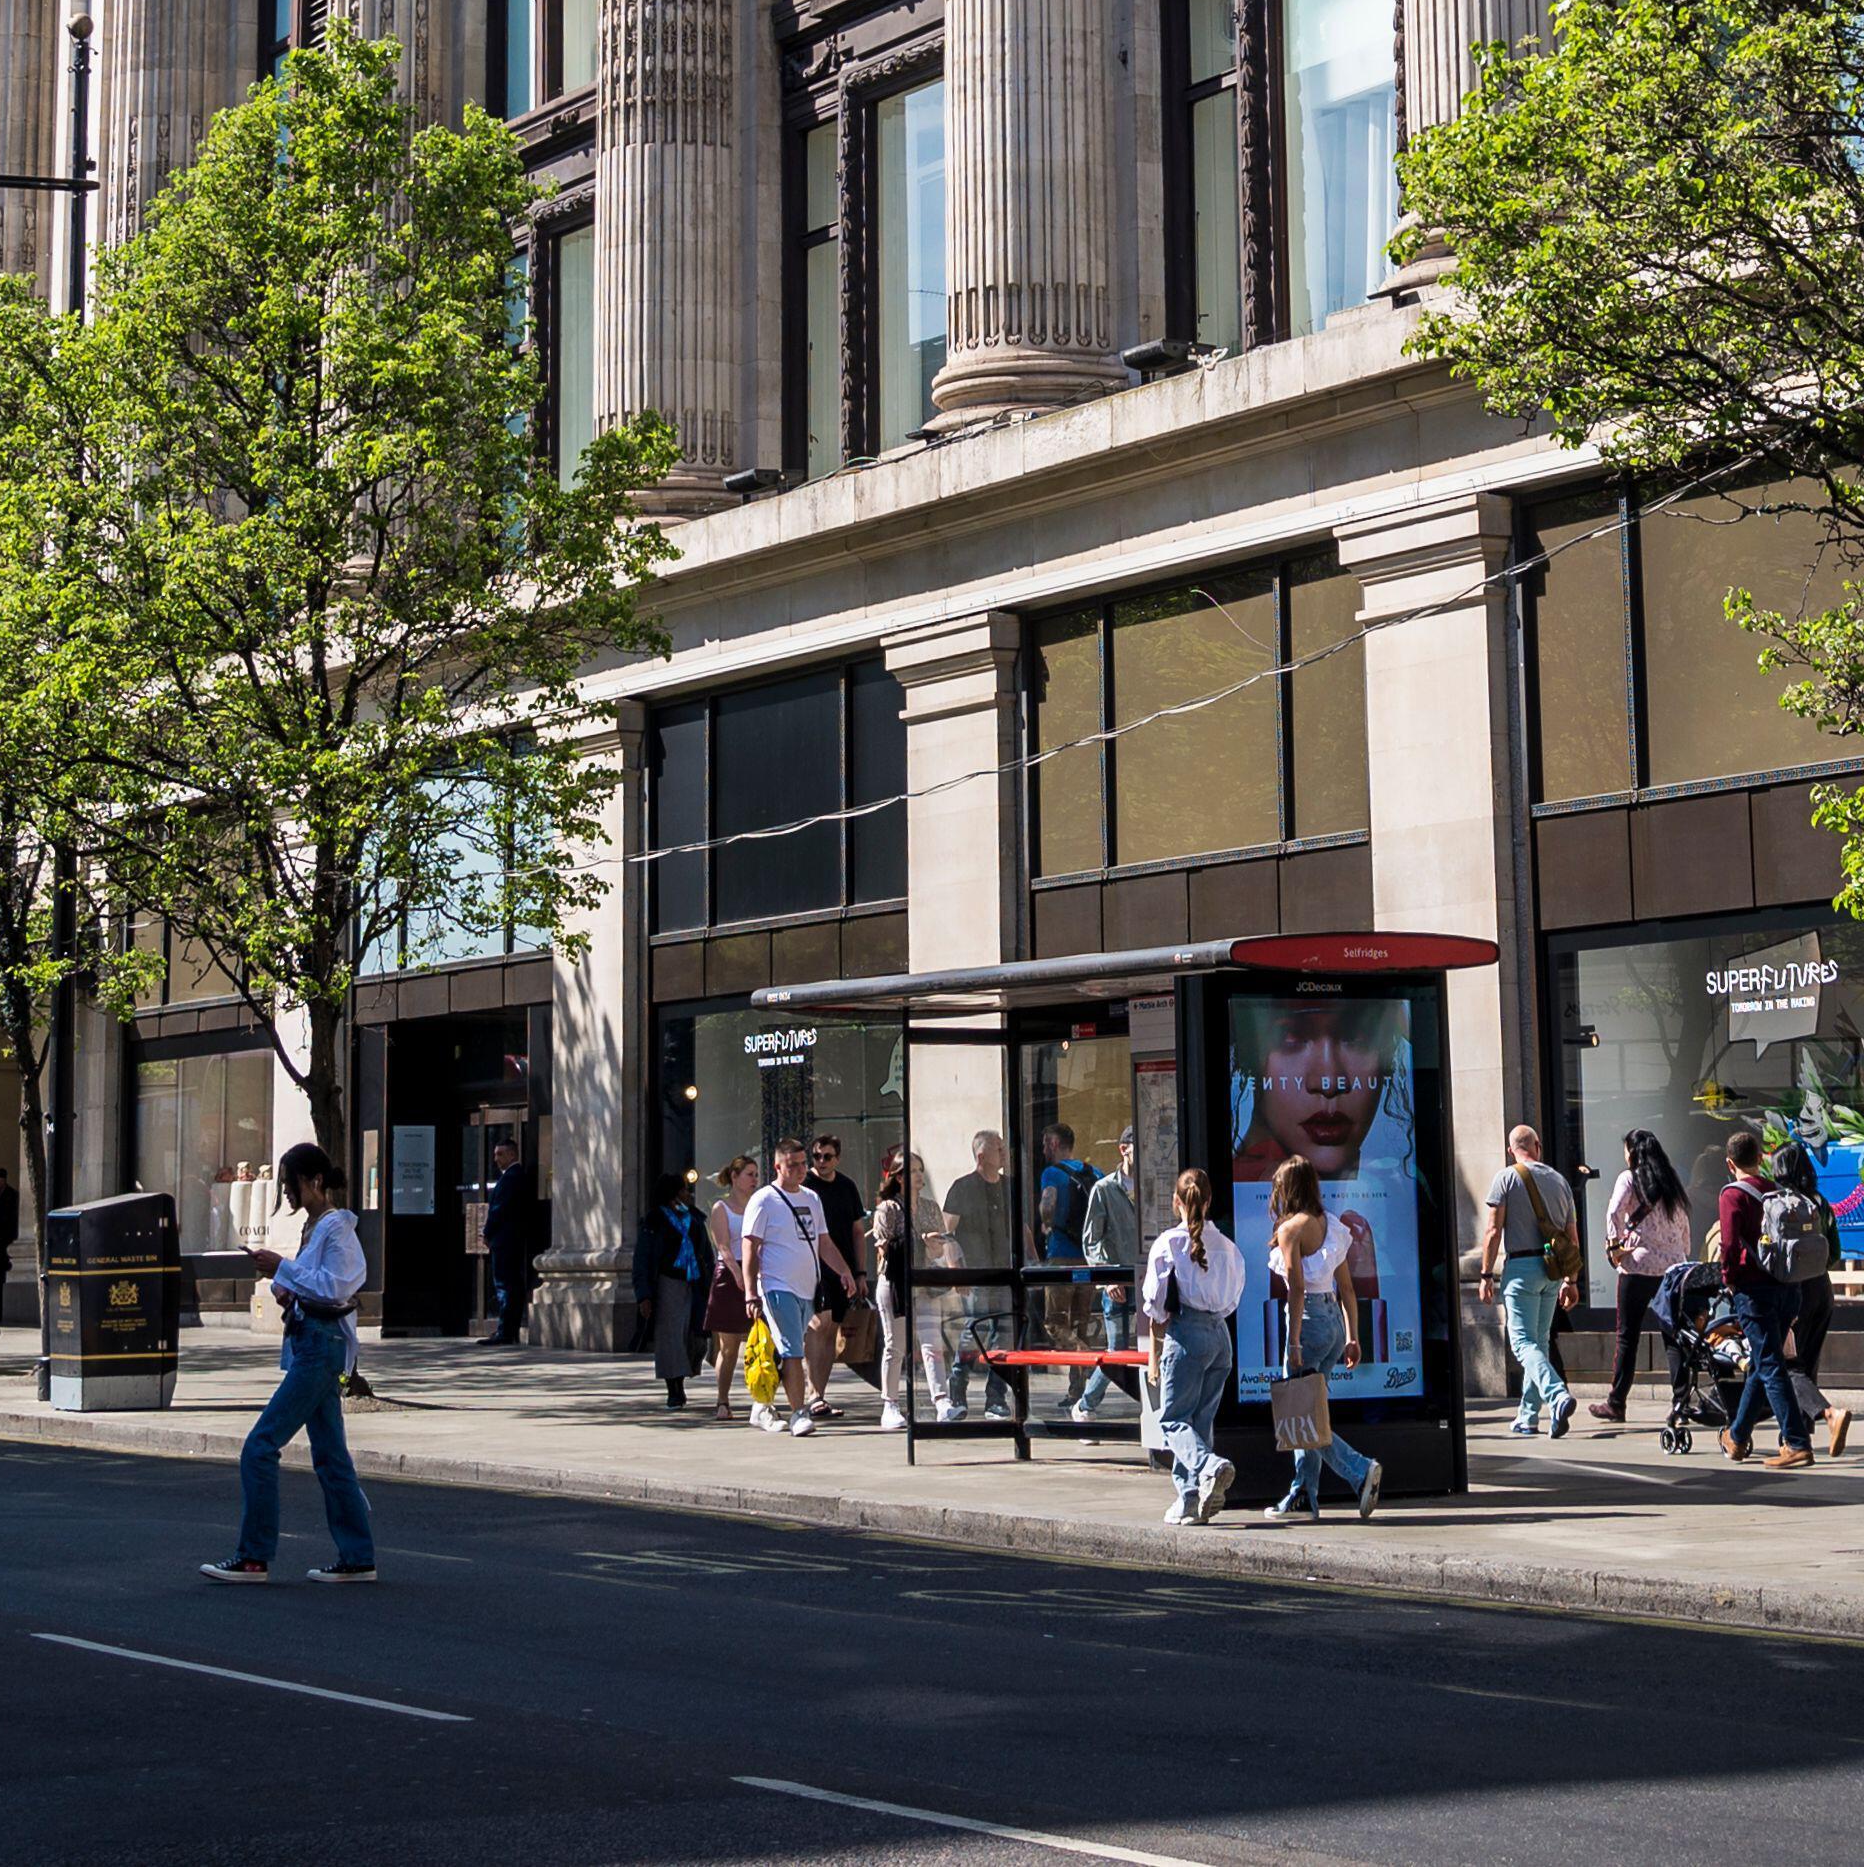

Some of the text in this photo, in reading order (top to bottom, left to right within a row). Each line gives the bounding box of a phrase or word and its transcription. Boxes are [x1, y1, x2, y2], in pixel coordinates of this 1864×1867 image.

[1344, 947, 1389, 960] Selfridges
[1706, 959, 1839, 995] SUPERFUTURES
[1296, 981, 1343, 993] JCDecaux
[1139, 999, 1168, 1009] Marble Arch
[1731, 996, 1816, 1013] TOMORROW IN THE MAKING
[744, 1028, 818, 1054] SUPERFUTURES
[1321, 1076, 1409, 1091] BEAUTY
[87, 1256, 119, 1265] GENERAL
[121, 1254, 143, 1263] WASTE
[146, 1254, 157, 1262] BIN
[1330, 1370, 1354, 1381] tores
[1384, 1366, 1417, 1389] Boots
[1276, 1413, 1320, 1447] ZARA
